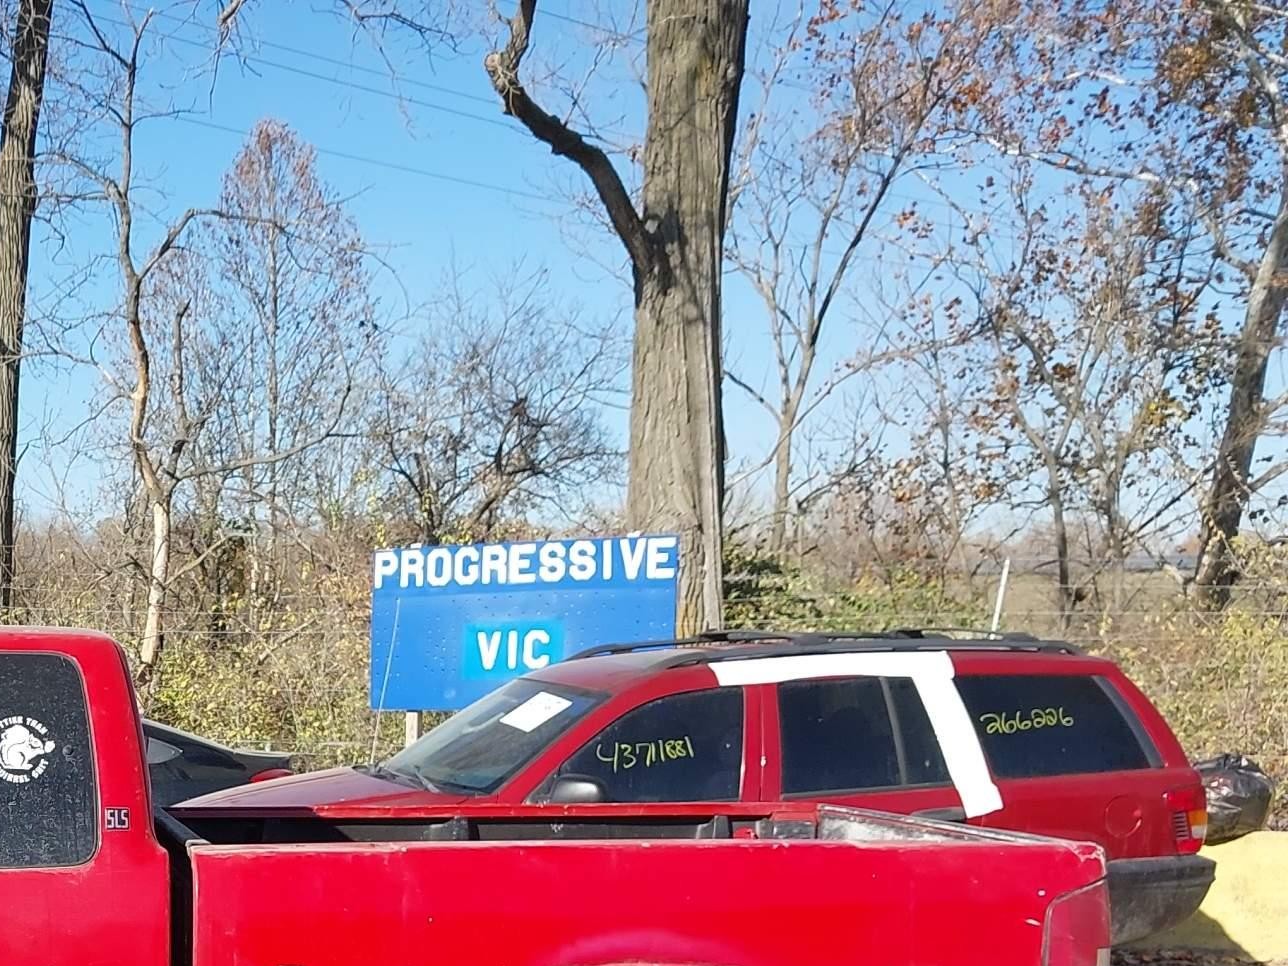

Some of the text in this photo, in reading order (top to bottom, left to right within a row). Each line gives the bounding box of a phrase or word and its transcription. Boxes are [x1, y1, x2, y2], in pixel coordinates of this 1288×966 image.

[374, 537, 676, 589] PROGRESSIVE
[477, 629, 550, 670] VIC
[979, 707, 1074, 734] 266226
[596, 736, 694, 774] 43711881
[107, 809, 129, 829] SLS
